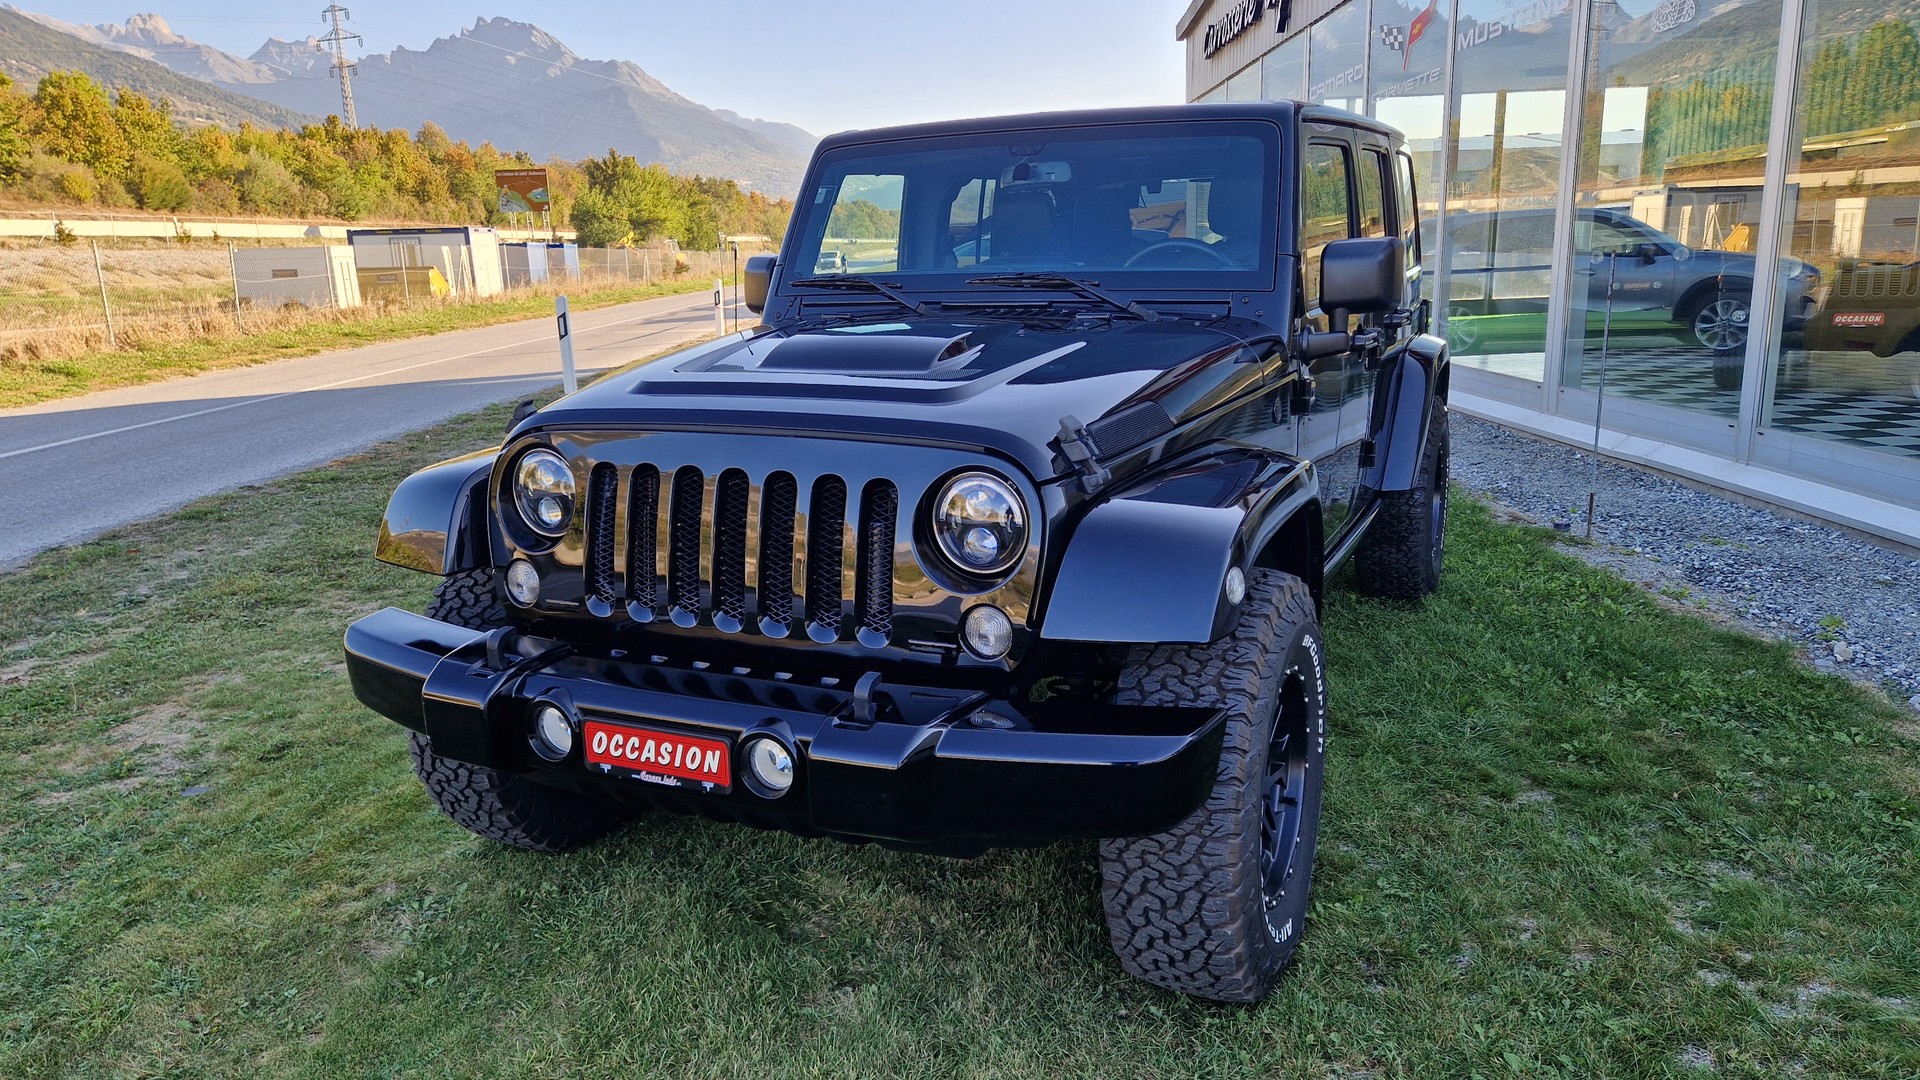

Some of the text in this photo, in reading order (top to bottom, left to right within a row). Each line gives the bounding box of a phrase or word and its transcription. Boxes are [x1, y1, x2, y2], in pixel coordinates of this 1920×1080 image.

[1309, 63, 1364, 101] CAMARO
[1371, 67, 1441, 104] CORVETTE
[1835, 315, 1882, 323] OCCASION
[1302, 634, 1324, 754] BFGoodrich
[592, 731, 721, 774] OCCASION
